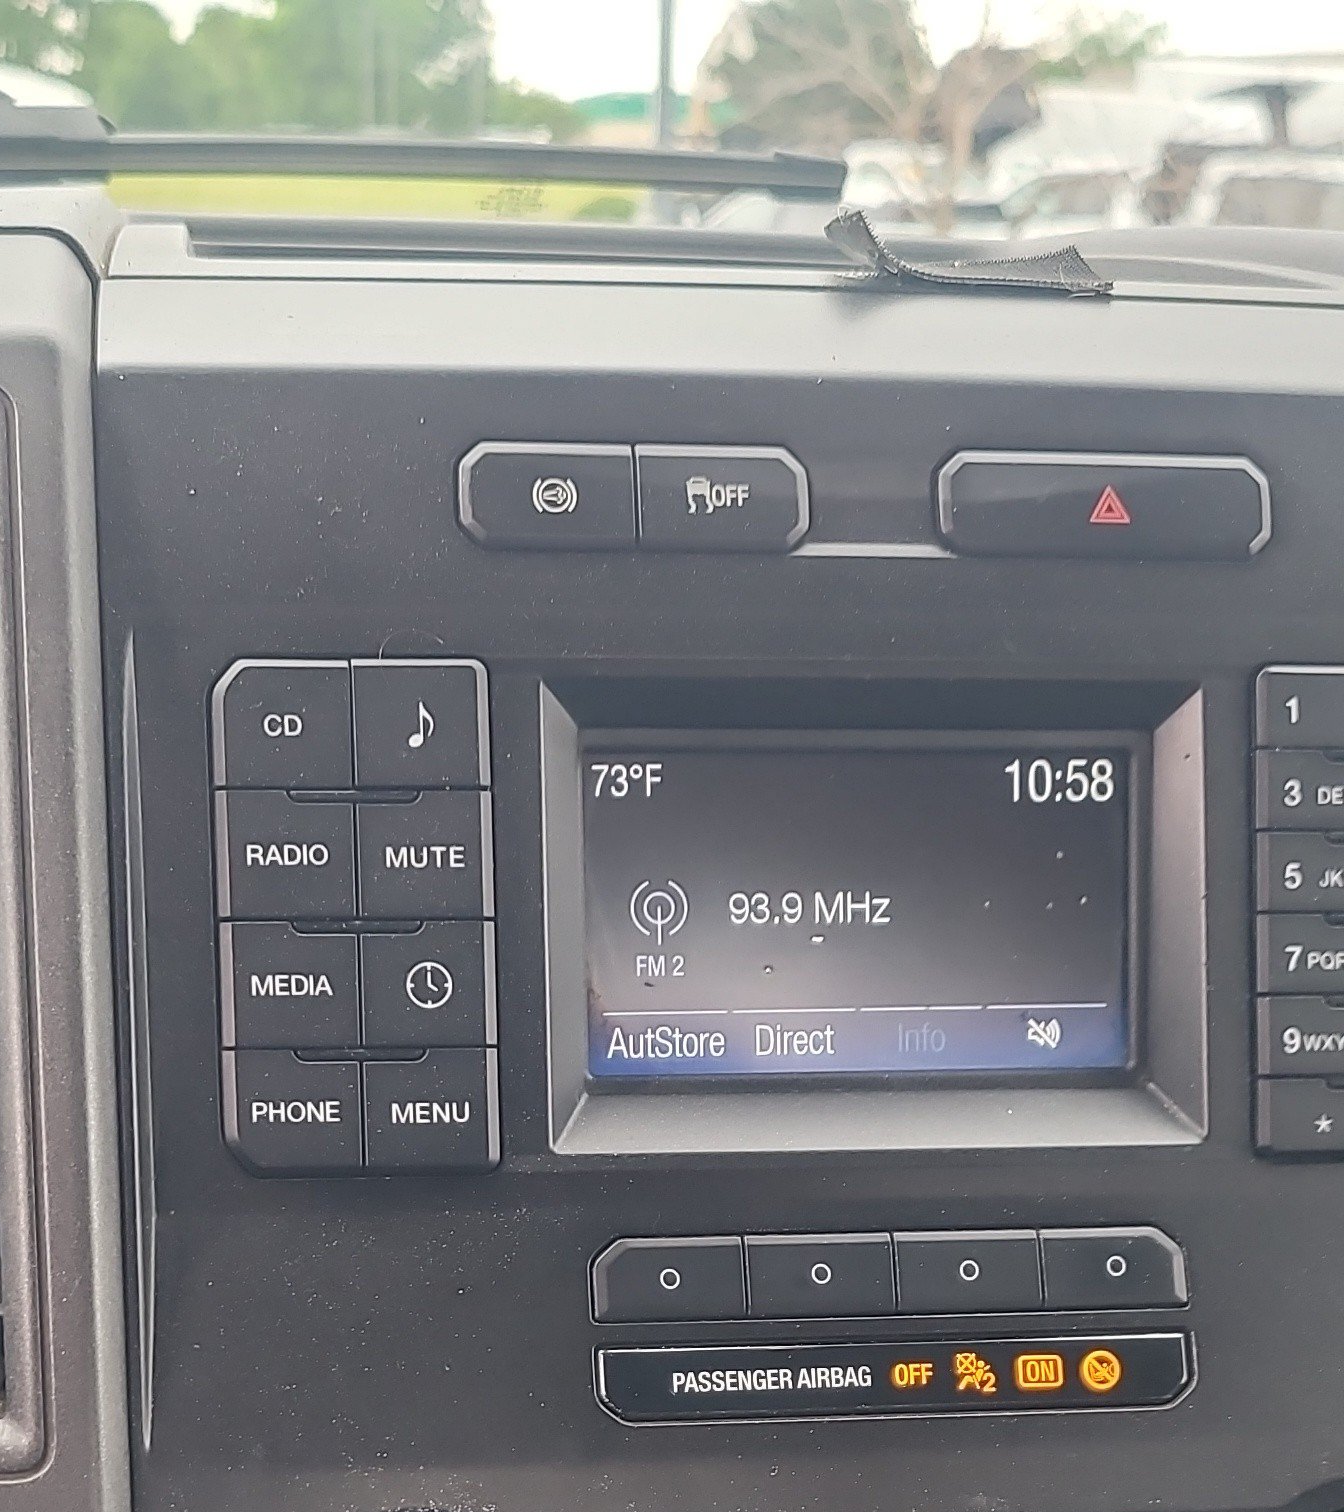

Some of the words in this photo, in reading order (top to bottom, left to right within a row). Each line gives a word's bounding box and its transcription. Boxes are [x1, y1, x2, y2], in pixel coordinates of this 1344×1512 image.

[711, 483, 750, 508] OFF
[1284, 694, 1301, 724] 1
[262, 713, 304, 738] CD
[590, 762, 664, 800] 73°F
[1003, 758, 1115, 804] 10:58
[1283, 778, 1304, 807] 3
[245, 843, 330, 867] RADIO
[384, 845, 466, 869] MUTE
[1283, 862, 1304, 890] 5
[728, 890, 804, 926] 93.9
[813, 890, 892, 926] MHz
[635, 956, 667, 979] FM
[672, 956, 686, 978] 2
[1283, 944, 1304, 972] 7
[250, 973, 334, 997] MEDIA
[607, 1026, 726, 1060] AutStore
[754, 1022, 836, 1057] Direct
[897, 1021, 947, 1054] Info
[1282, 1026, 1302, 1054] 9
[250, 1100, 342, 1124] PHONE
[390, 1101, 471, 1125] MENU
[671, 1369, 794, 1394] PASSENGER
[797, 1365, 873, 1391] AIRBAG
[894, 1363, 934, 1387] OFF
[1025, 1360, 1057, 1383] ON
